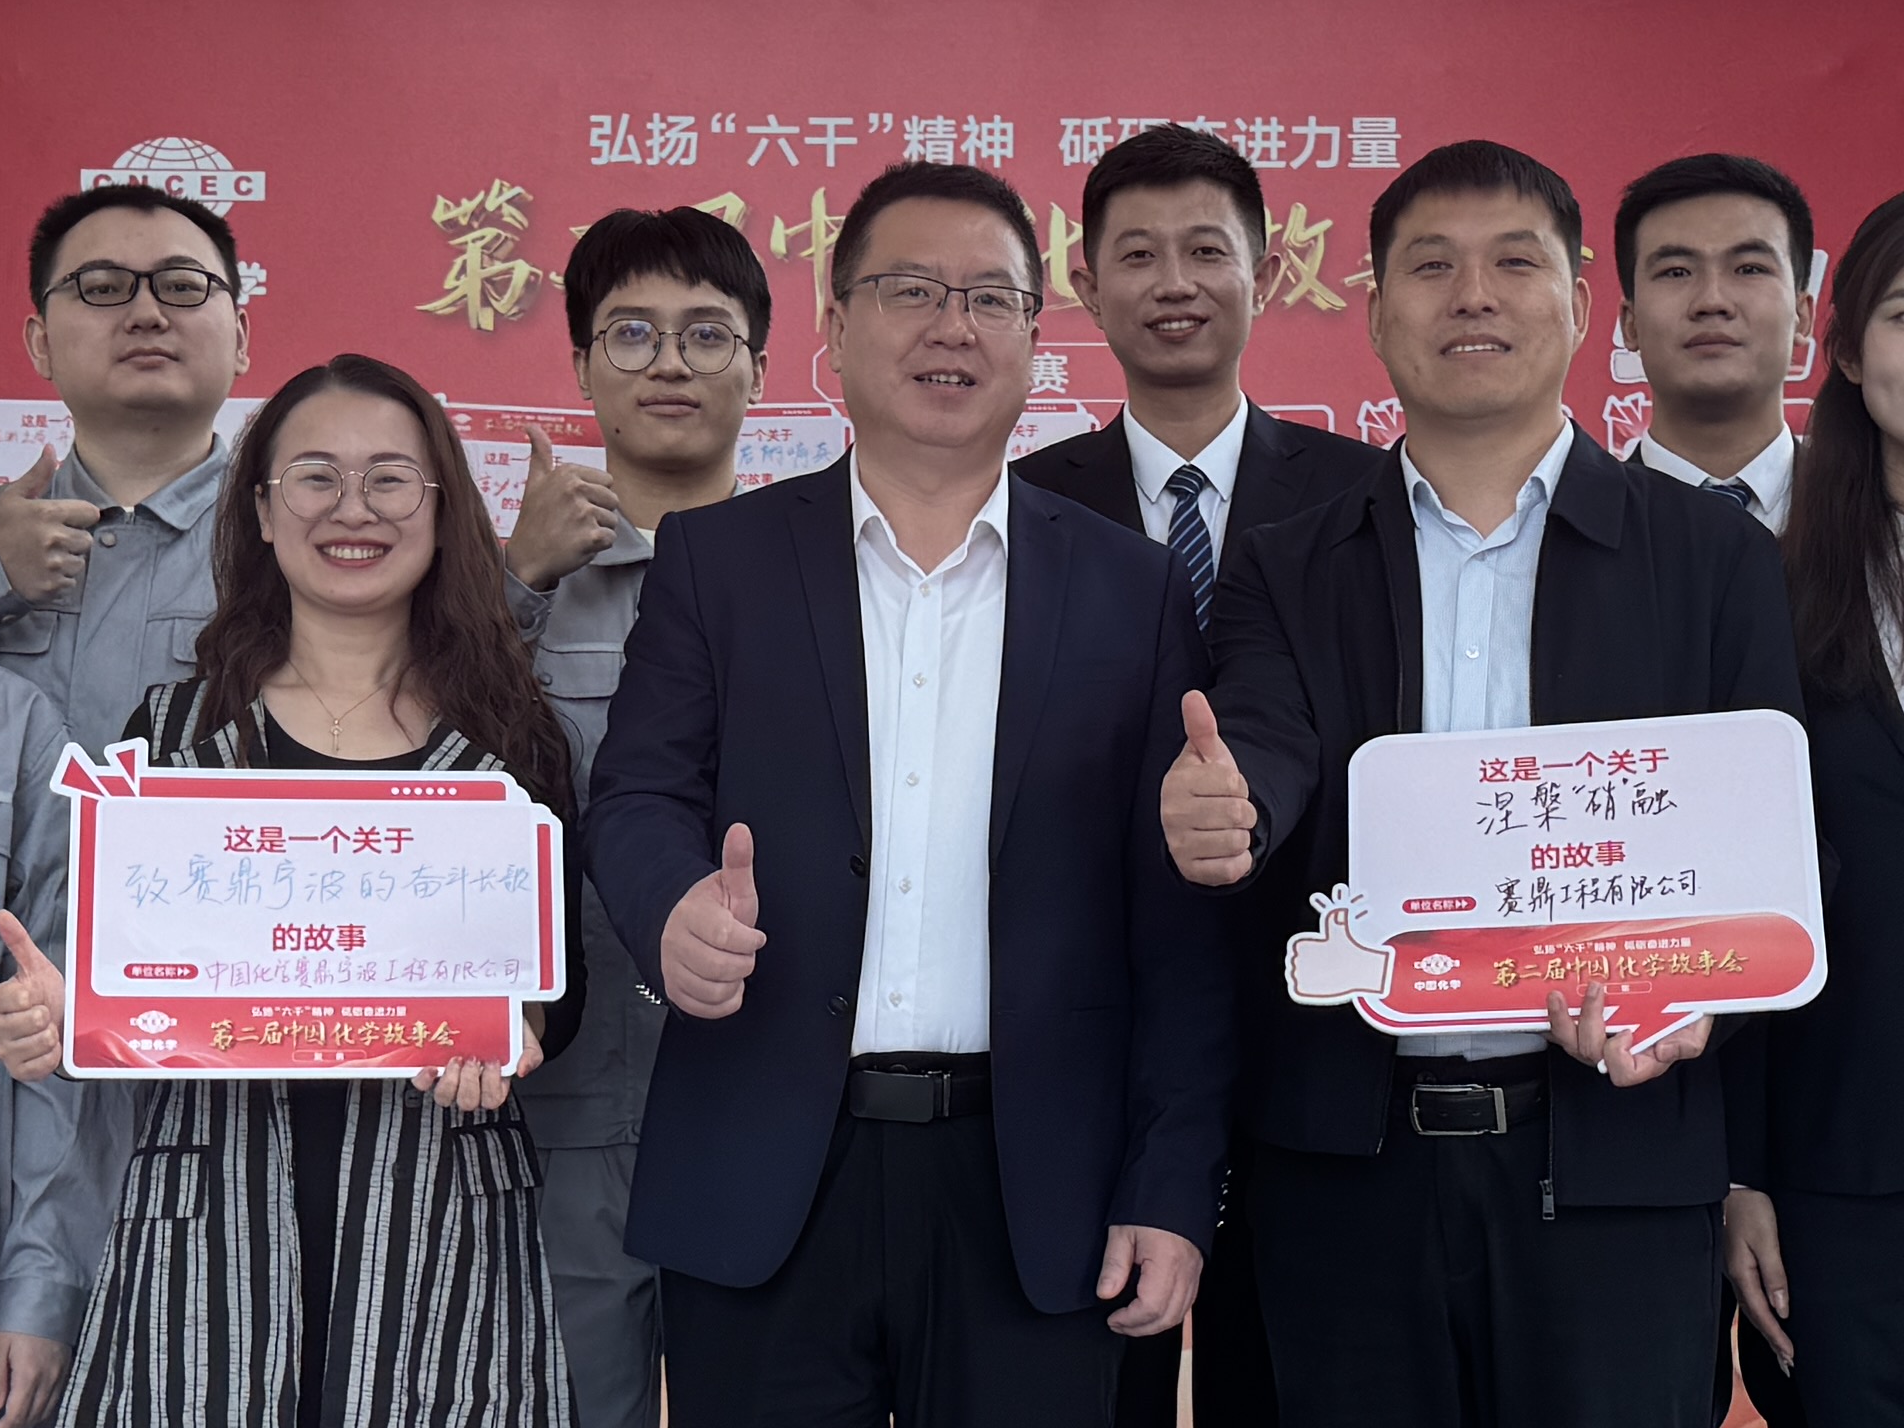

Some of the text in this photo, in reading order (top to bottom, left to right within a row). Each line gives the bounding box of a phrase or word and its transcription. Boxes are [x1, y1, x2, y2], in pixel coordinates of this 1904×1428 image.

[1478, 747, 1670, 783] 这是一个关于
[223, 825, 415, 855] 这是一个关于
[1530, 840, 1626, 871] 的故事
[271, 923, 368, 953] 的故事
[1491, 948, 1752, 989] 第二届中国化学故事会
[208, 1017, 462, 1053] 第二届中国化学故事会
